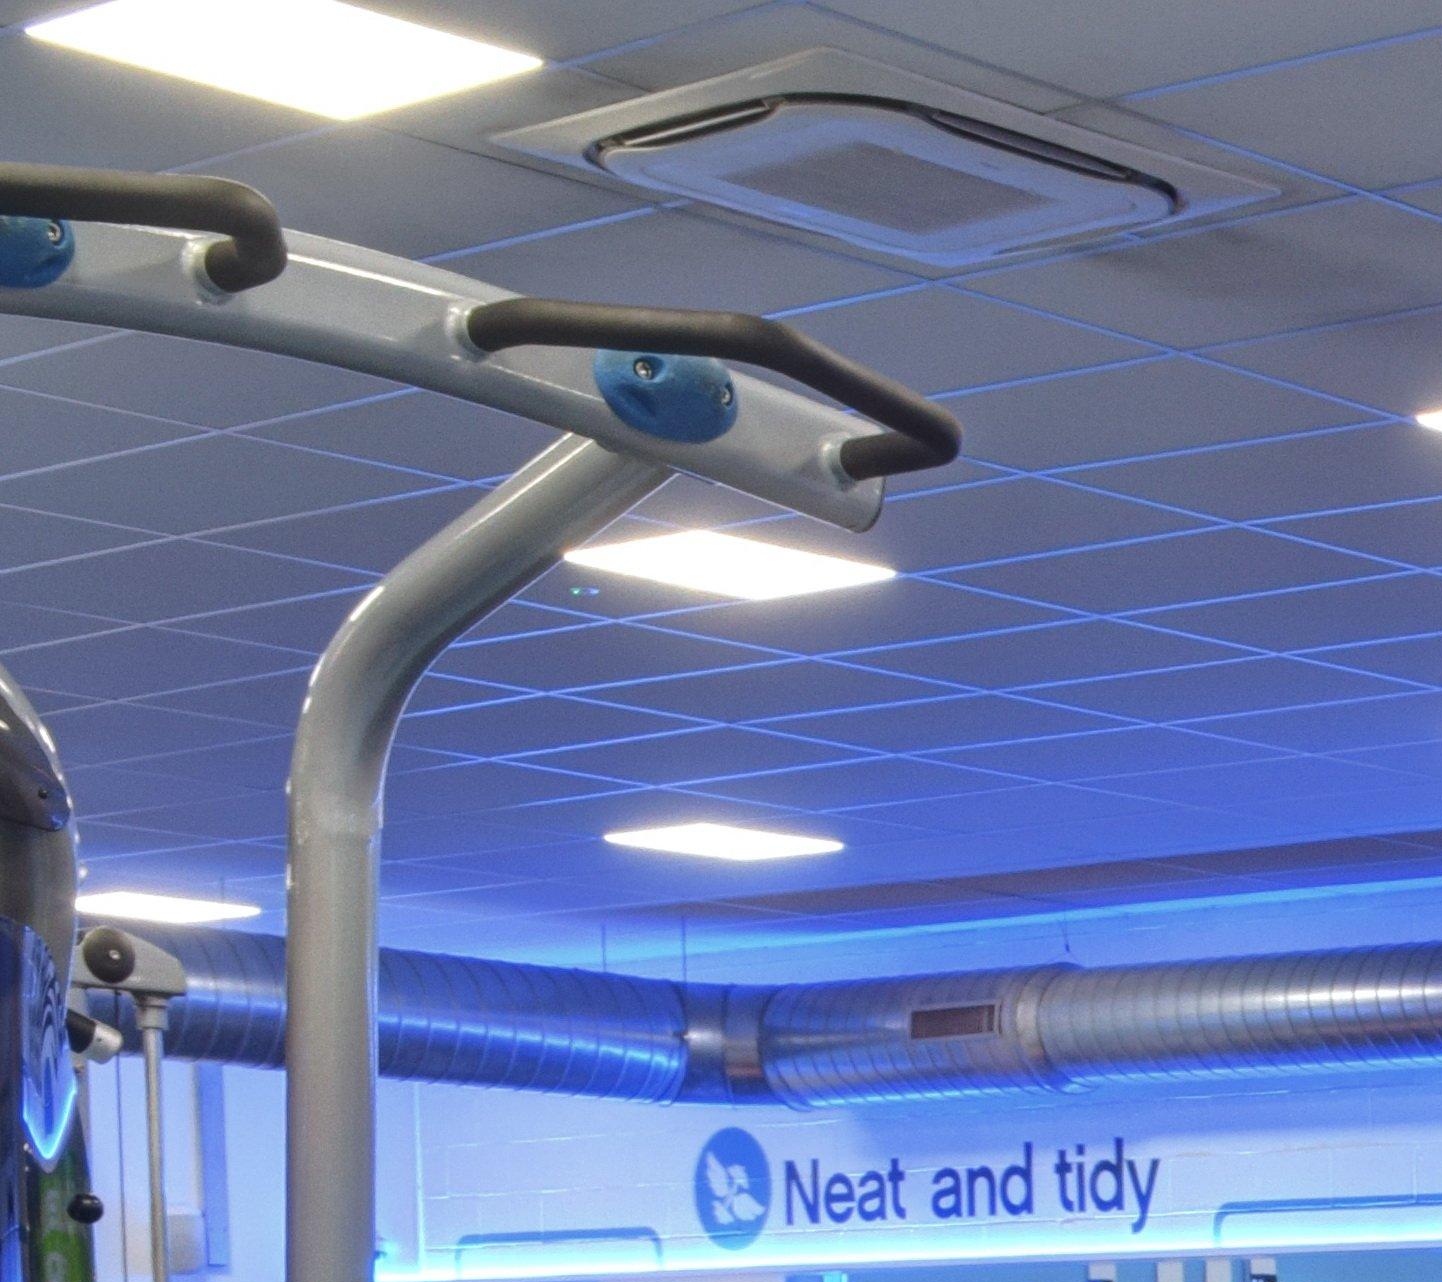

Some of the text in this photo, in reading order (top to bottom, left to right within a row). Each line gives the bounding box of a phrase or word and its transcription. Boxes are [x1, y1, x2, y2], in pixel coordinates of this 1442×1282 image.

[784, 1136, 1161, 1233] Neat and tidy
